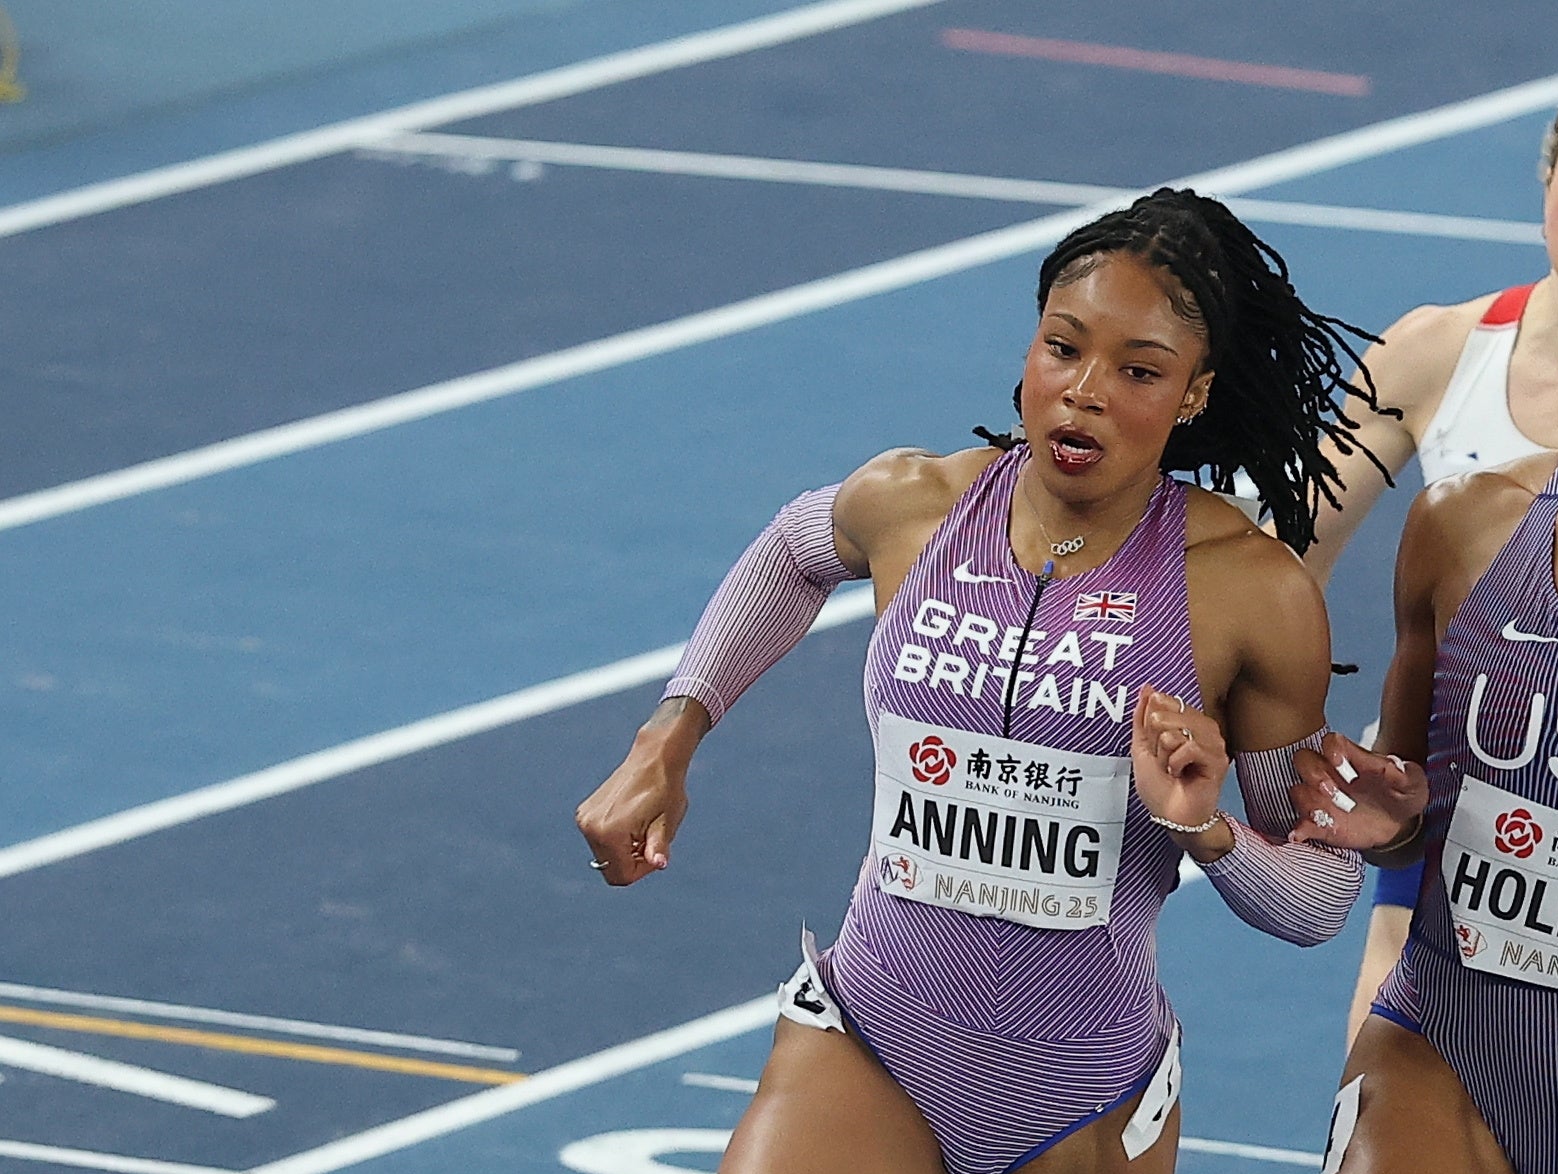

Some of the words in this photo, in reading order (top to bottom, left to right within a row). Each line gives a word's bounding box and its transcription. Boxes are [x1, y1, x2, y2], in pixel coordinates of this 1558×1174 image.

[912, 598, 1133, 672] GREAT
[894, 642, 1130, 724] BRITAIN
[965, 780, 999, 795] BANK
[1004, 788, 1019, 799] OF
[1023, 792, 1080, 810] NANJING
[967, 748, 1083, 797] 南京银行
[889, 789, 1101, 879] ANNING
[934, 872, 1061, 917] NANJING
[1064, 895, 1099, 919] 25
